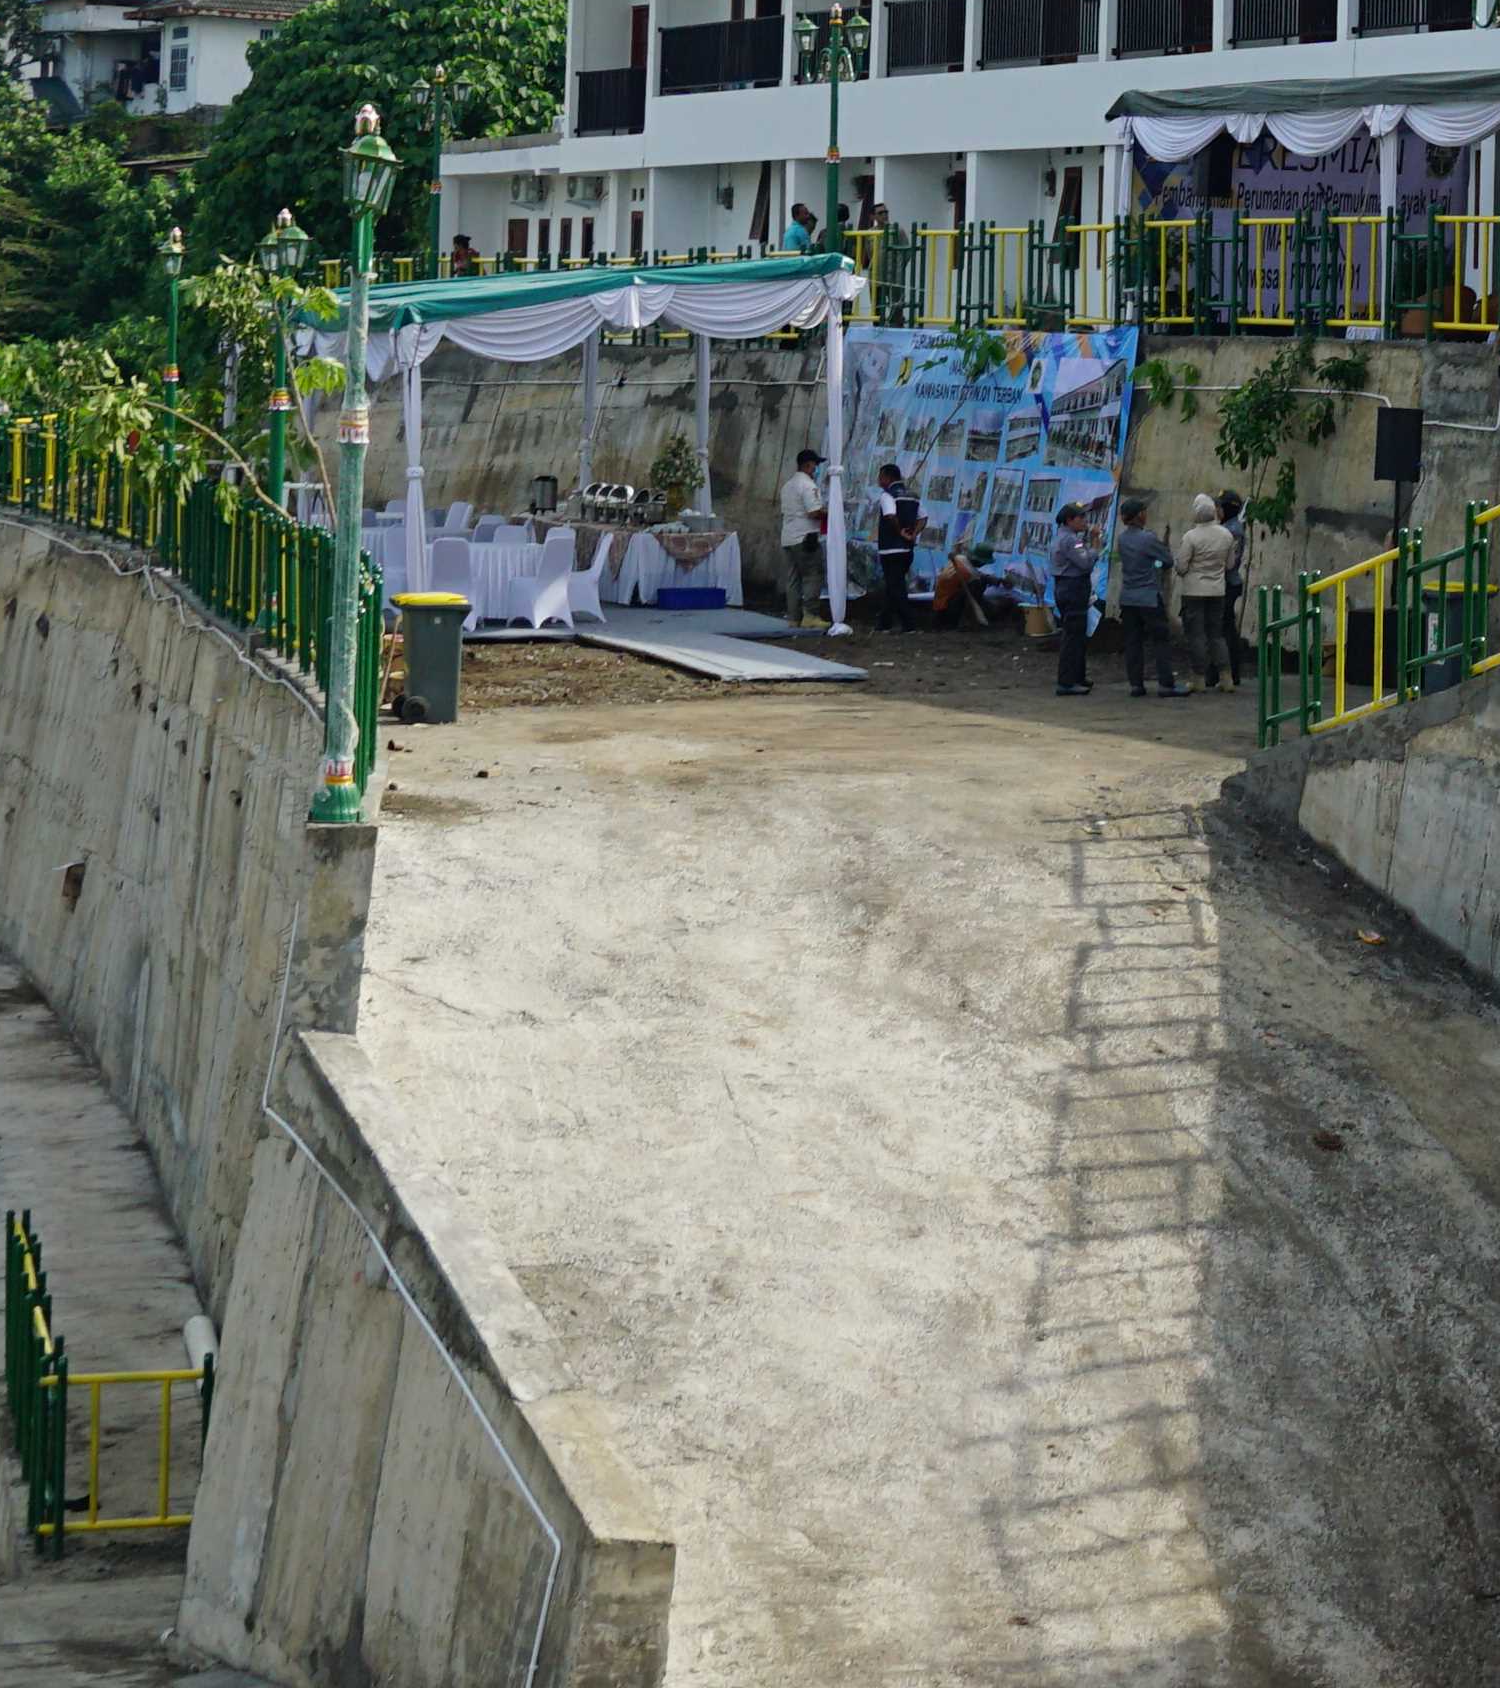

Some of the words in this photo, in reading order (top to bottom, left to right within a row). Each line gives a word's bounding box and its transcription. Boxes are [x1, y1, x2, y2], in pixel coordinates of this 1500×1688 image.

[1238, 182, 1299, 211] Perumahan
[1325, 185, 1381, 215] Permukim
[1401, 189, 1426, 222] ayak
[1430, 188, 1453, 213] Hni
[1237, 263, 1279, 291] Kwasa
